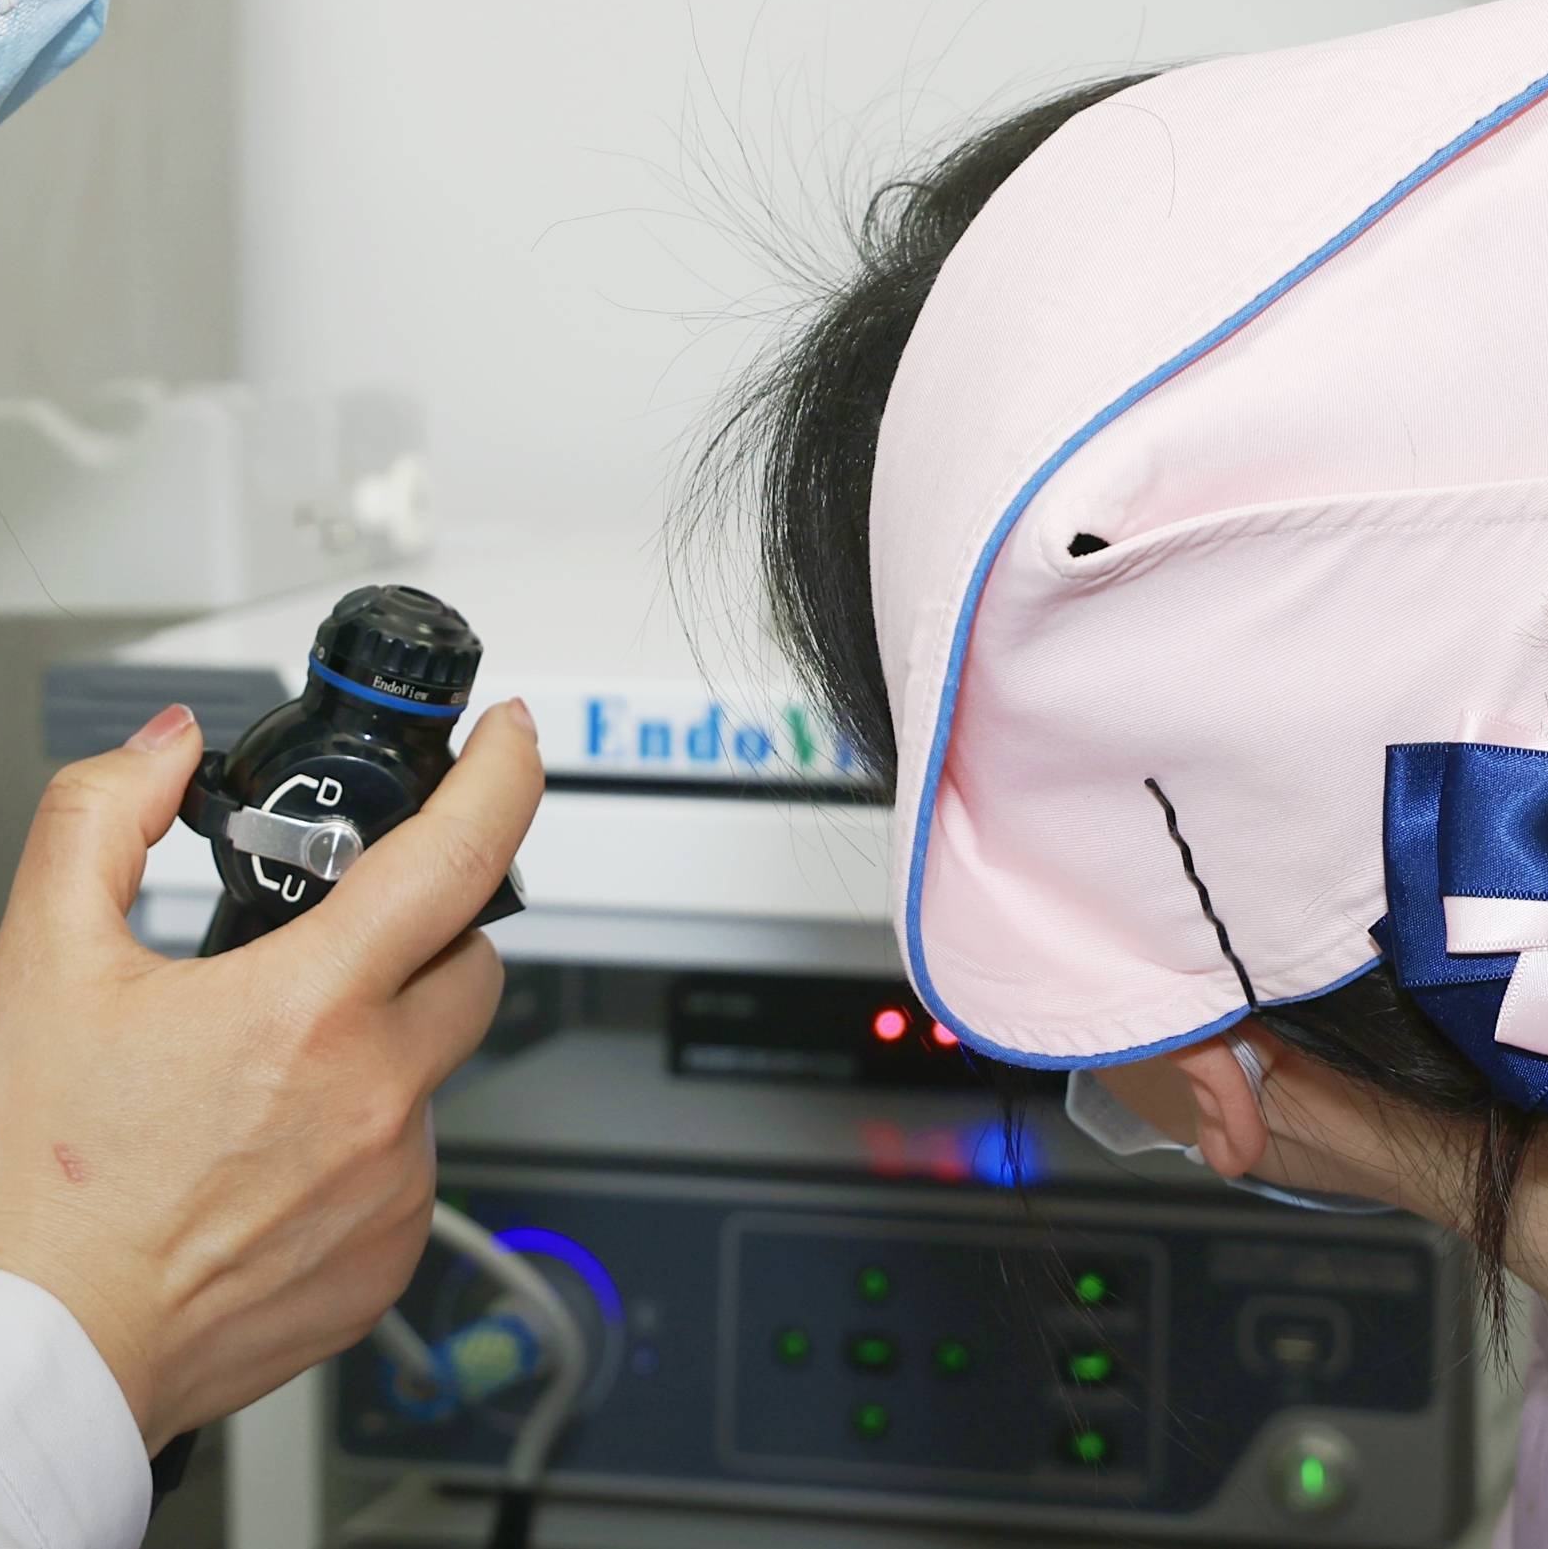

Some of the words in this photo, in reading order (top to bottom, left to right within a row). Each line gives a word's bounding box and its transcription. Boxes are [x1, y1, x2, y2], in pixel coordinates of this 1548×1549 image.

[372, 675, 429, 701] EndoView
[316, 776, 343, 807] D
[281, 874, 307, 902] U
